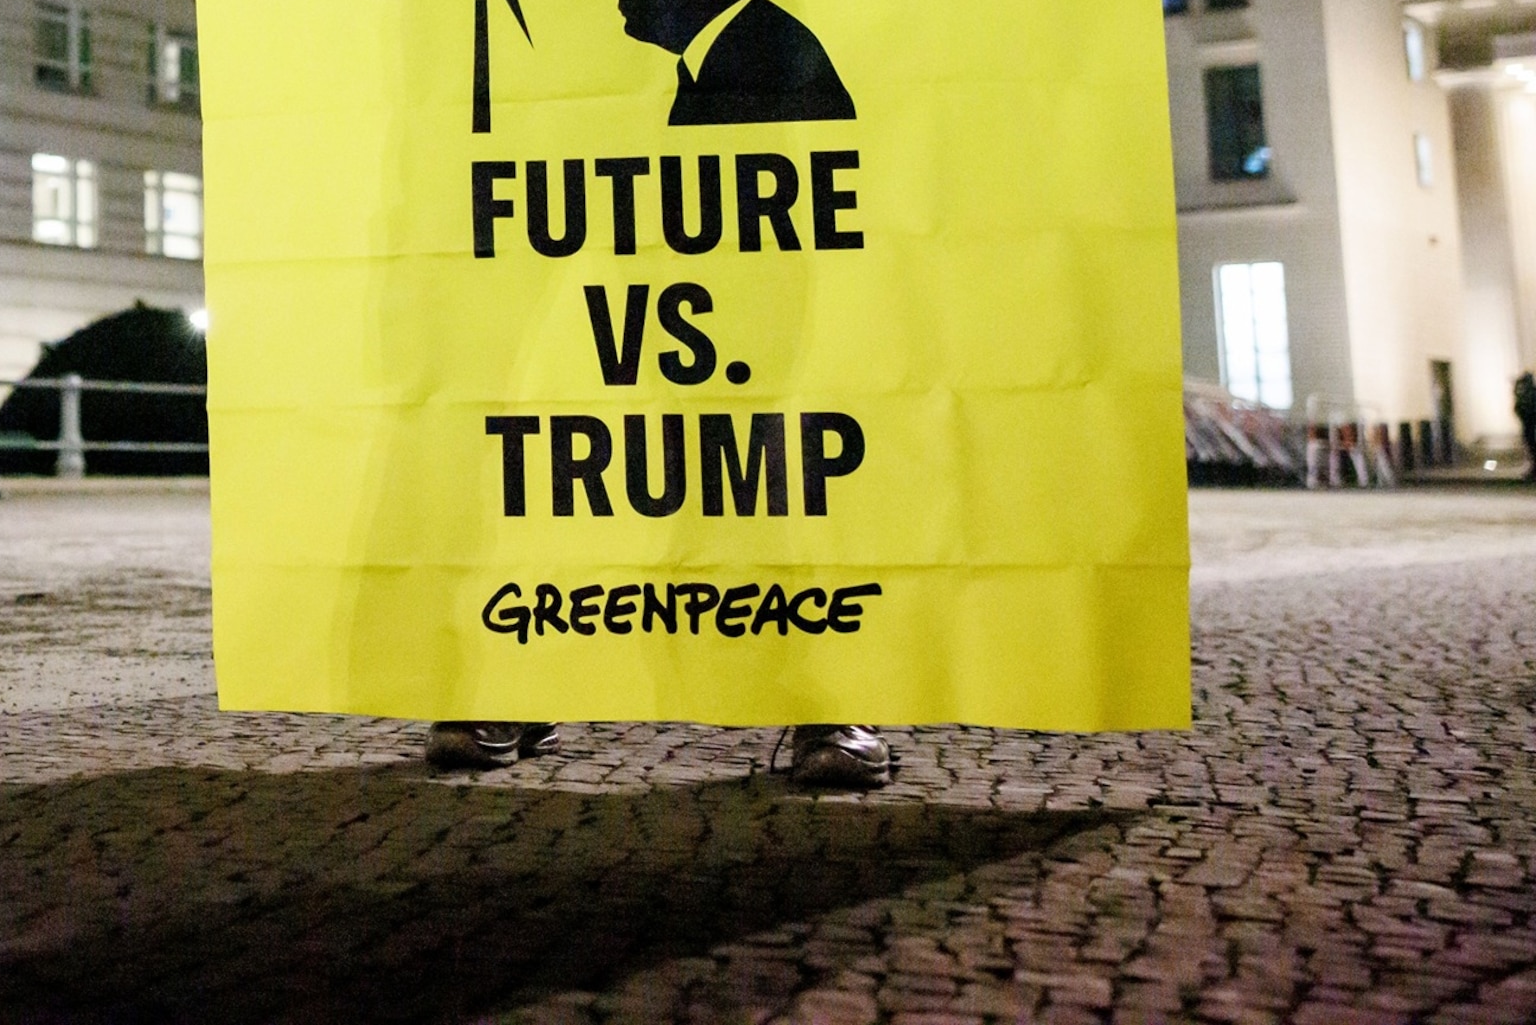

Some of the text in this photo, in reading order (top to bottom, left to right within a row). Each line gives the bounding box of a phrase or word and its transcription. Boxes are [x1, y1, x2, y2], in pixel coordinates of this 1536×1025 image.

[471, 149, 864, 259] FUTURE
[583, 282, 752, 387] VS.
[485, 412, 866, 518] TRUMP
[481, 582, 882, 645] GREENPEACE
